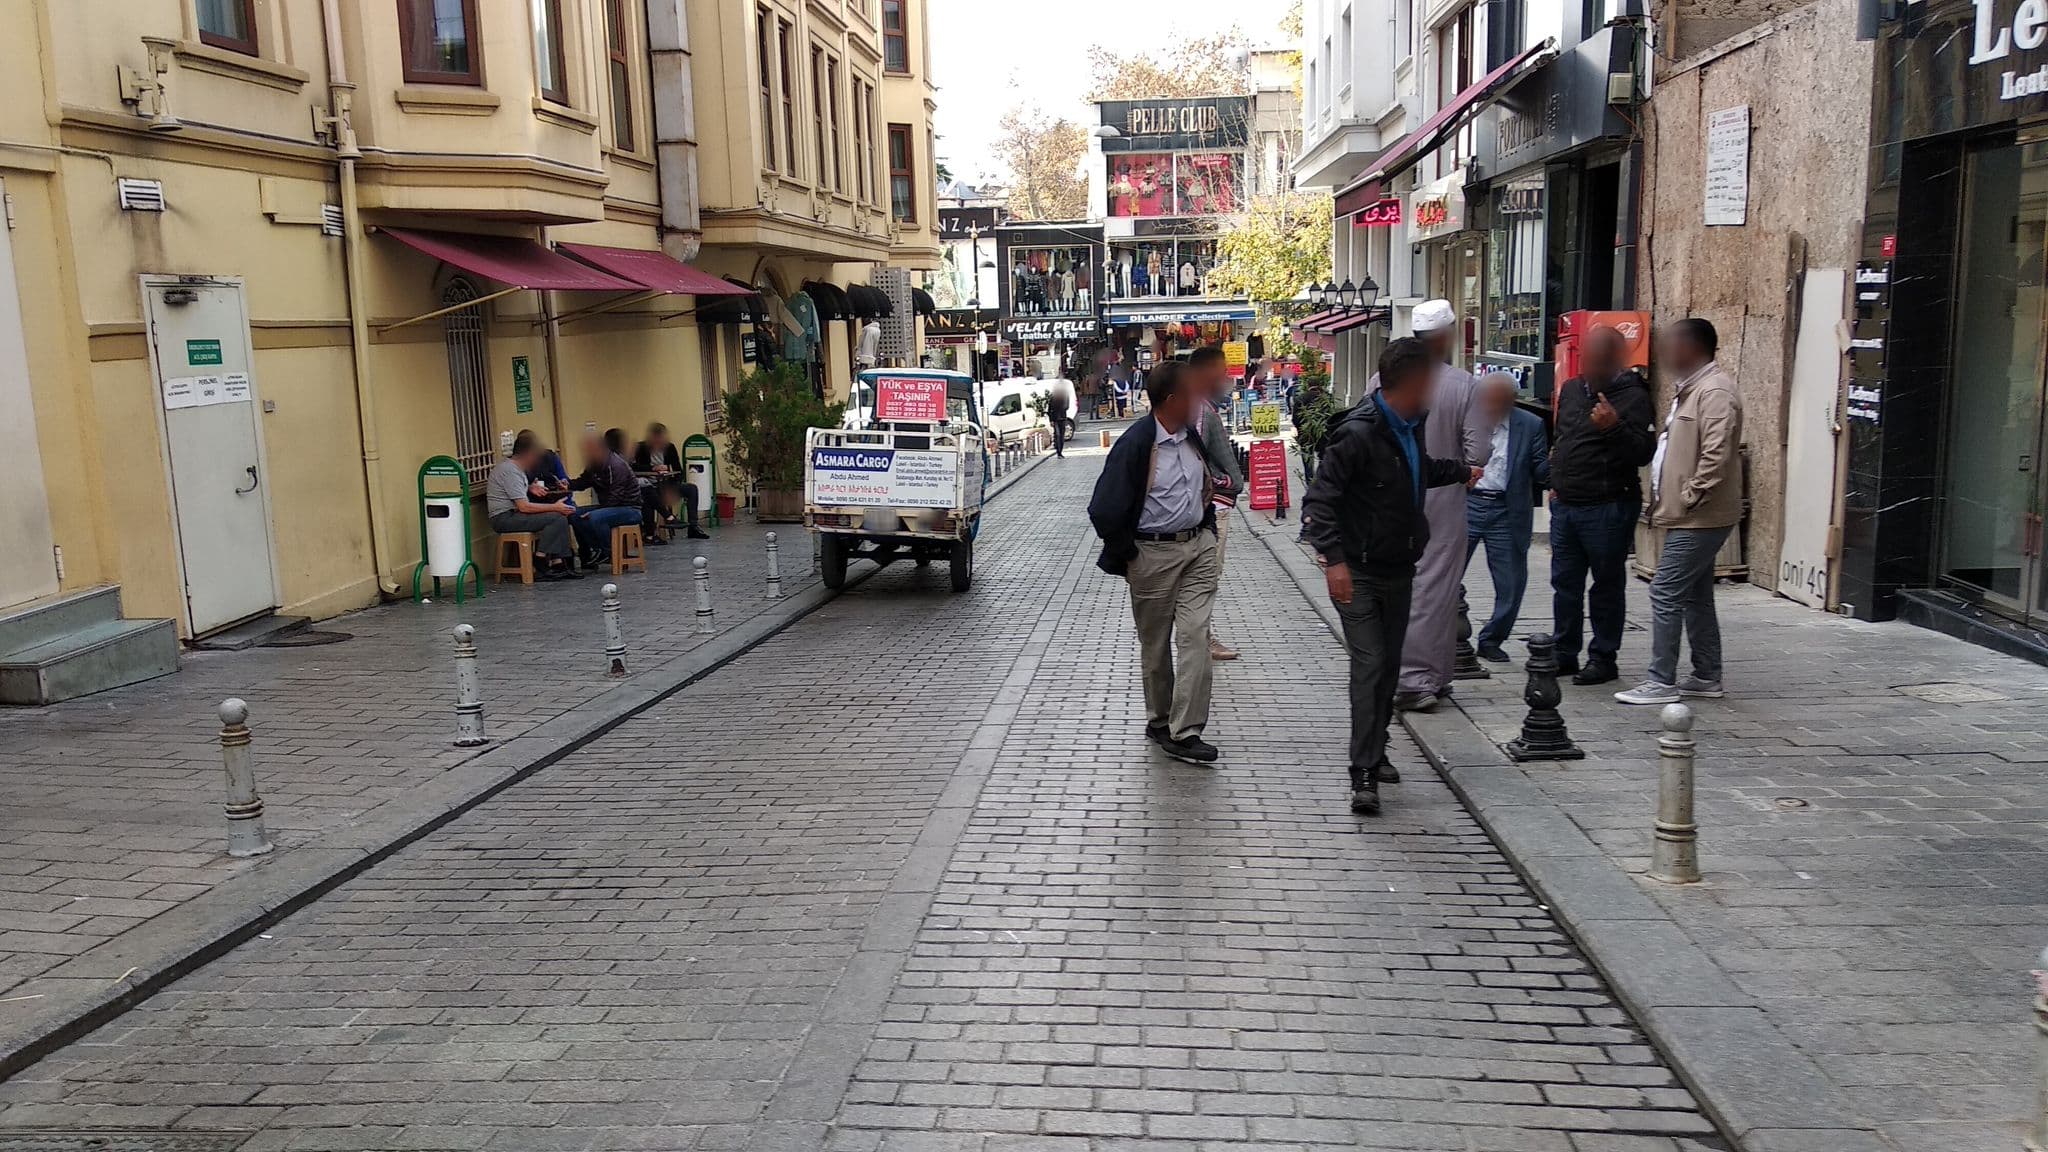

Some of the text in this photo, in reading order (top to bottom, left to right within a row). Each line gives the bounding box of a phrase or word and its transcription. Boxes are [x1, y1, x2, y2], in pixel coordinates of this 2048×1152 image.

[1132, 107, 1177, 134] PELLE
[1180, 105, 1217, 133] CLUB
[1190, 313, 1231, 321] Collection
[1008, 321, 1051, 333] VELAT
[1053, 320, 1096, 332] PELLE
[1017, 331, 1079, 340] Leather & Fur
[881, 380, 902, 390] YÜK
[917, 381, 944, 393] EŞYA
[892, 391, 931, 402] TAŞINIR
[1253, 424, 1280, 434] VALEN
[815, 452, 889, 469] ASMARA CARGO
